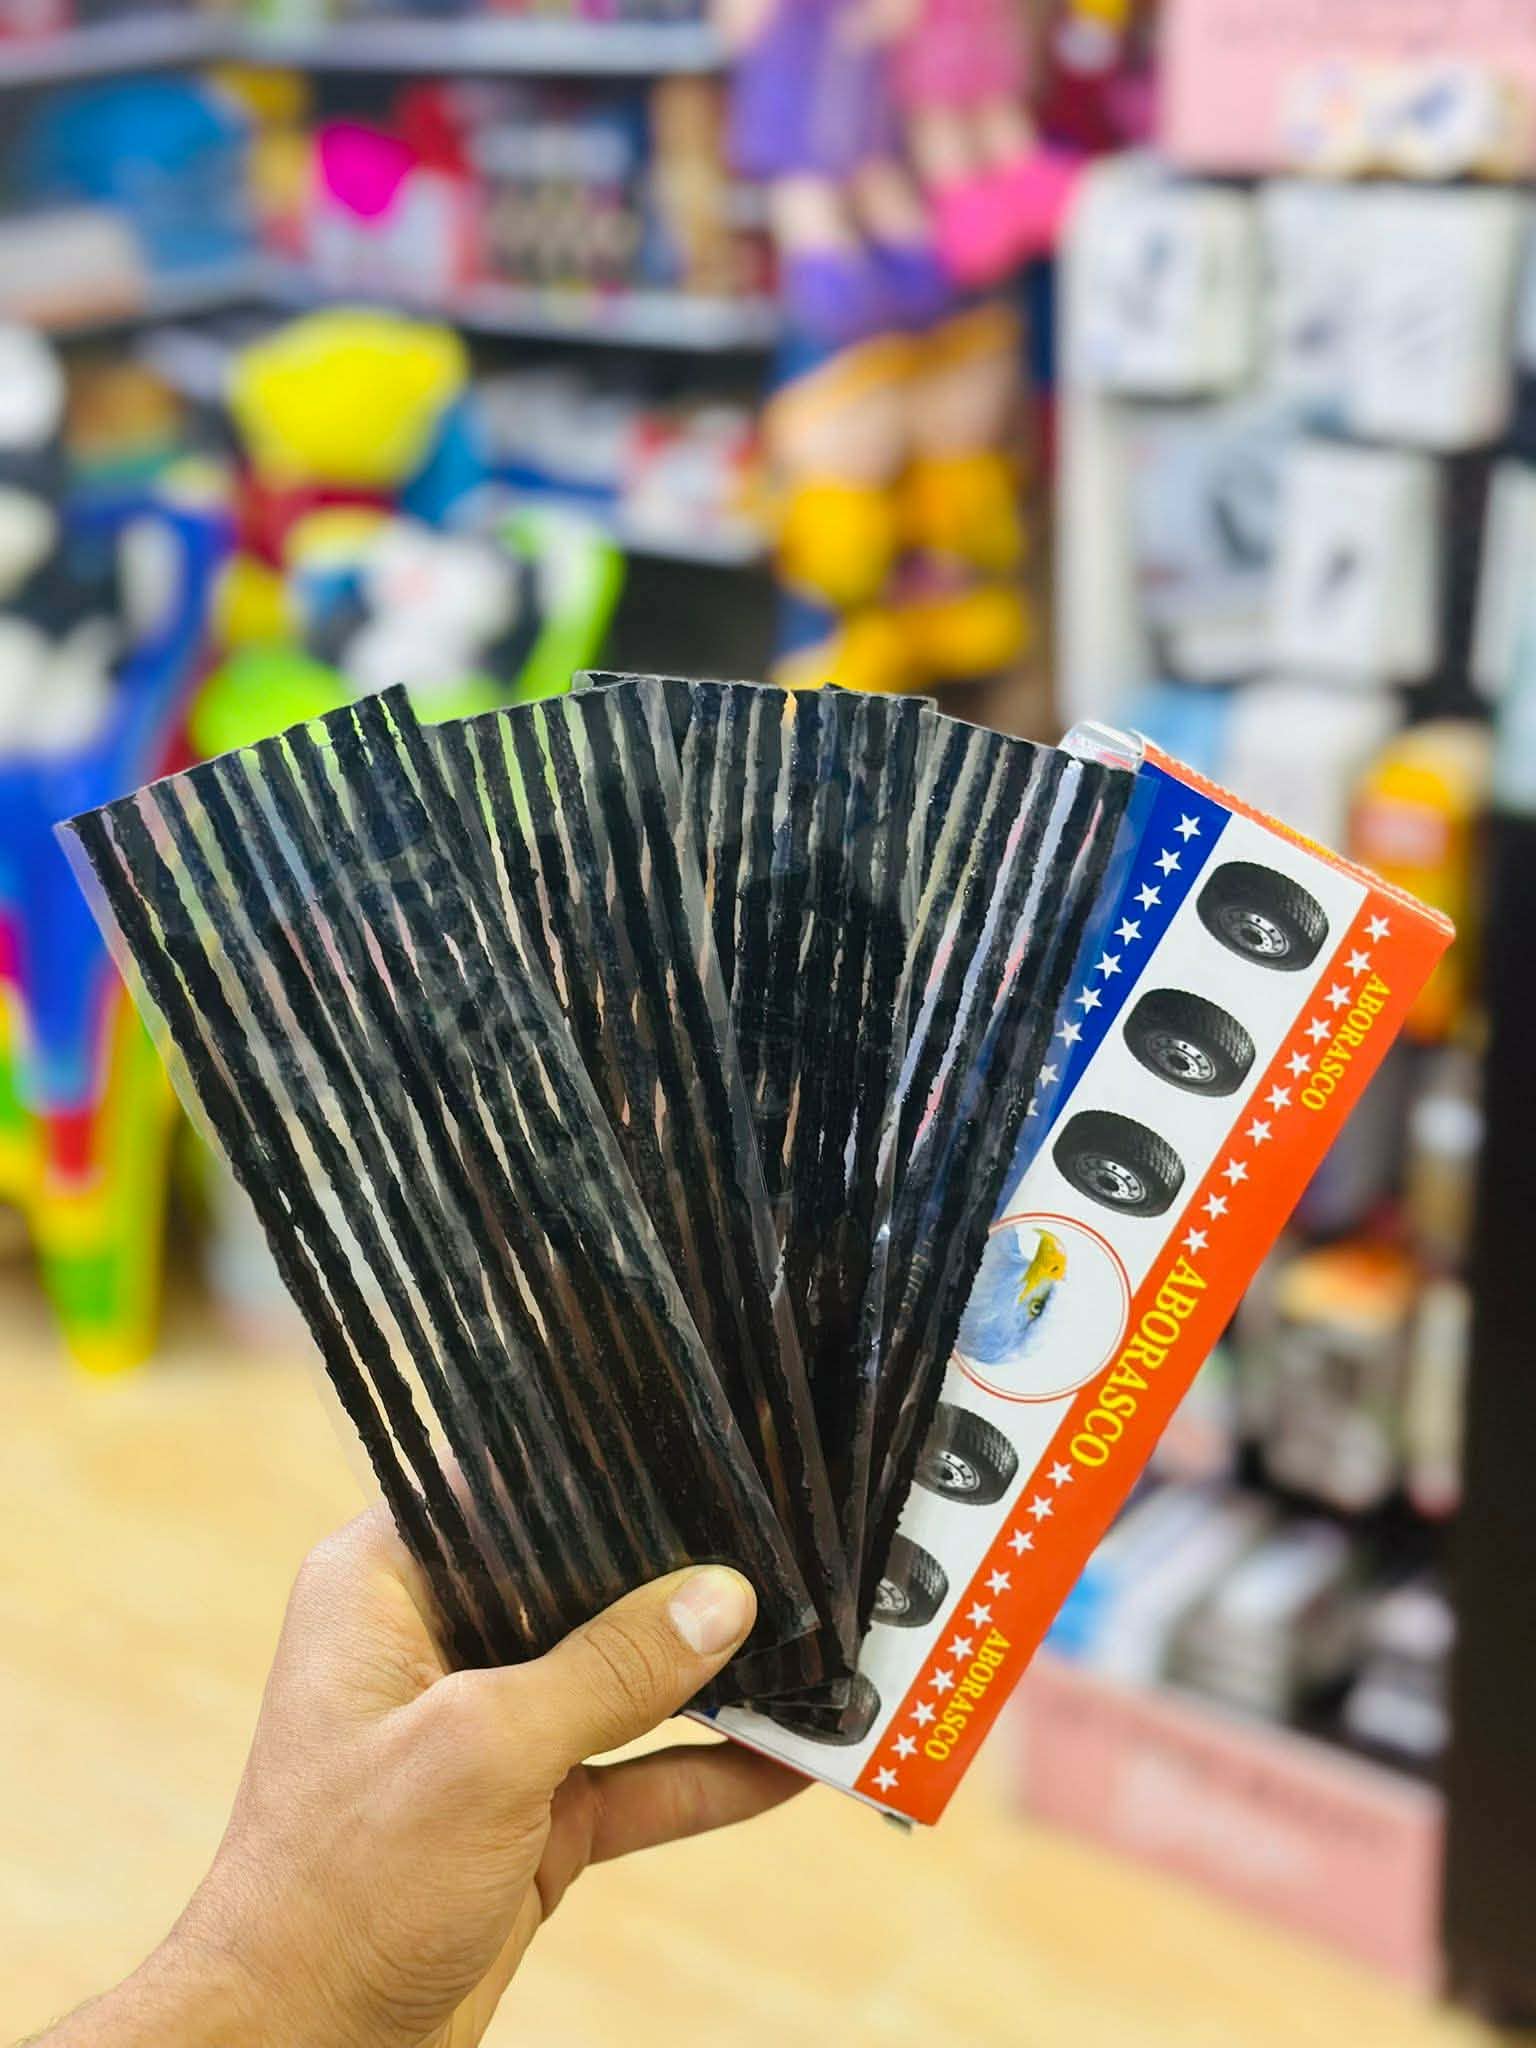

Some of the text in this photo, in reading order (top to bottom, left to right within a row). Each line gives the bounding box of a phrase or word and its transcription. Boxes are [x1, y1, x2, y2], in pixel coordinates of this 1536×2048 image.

[1301, 973, 1391, 1111] ABORASCO
[1069, 1255, 1208, 1467] ABORASCO
[924, 1628, 1011, 1761] ABORASCO
